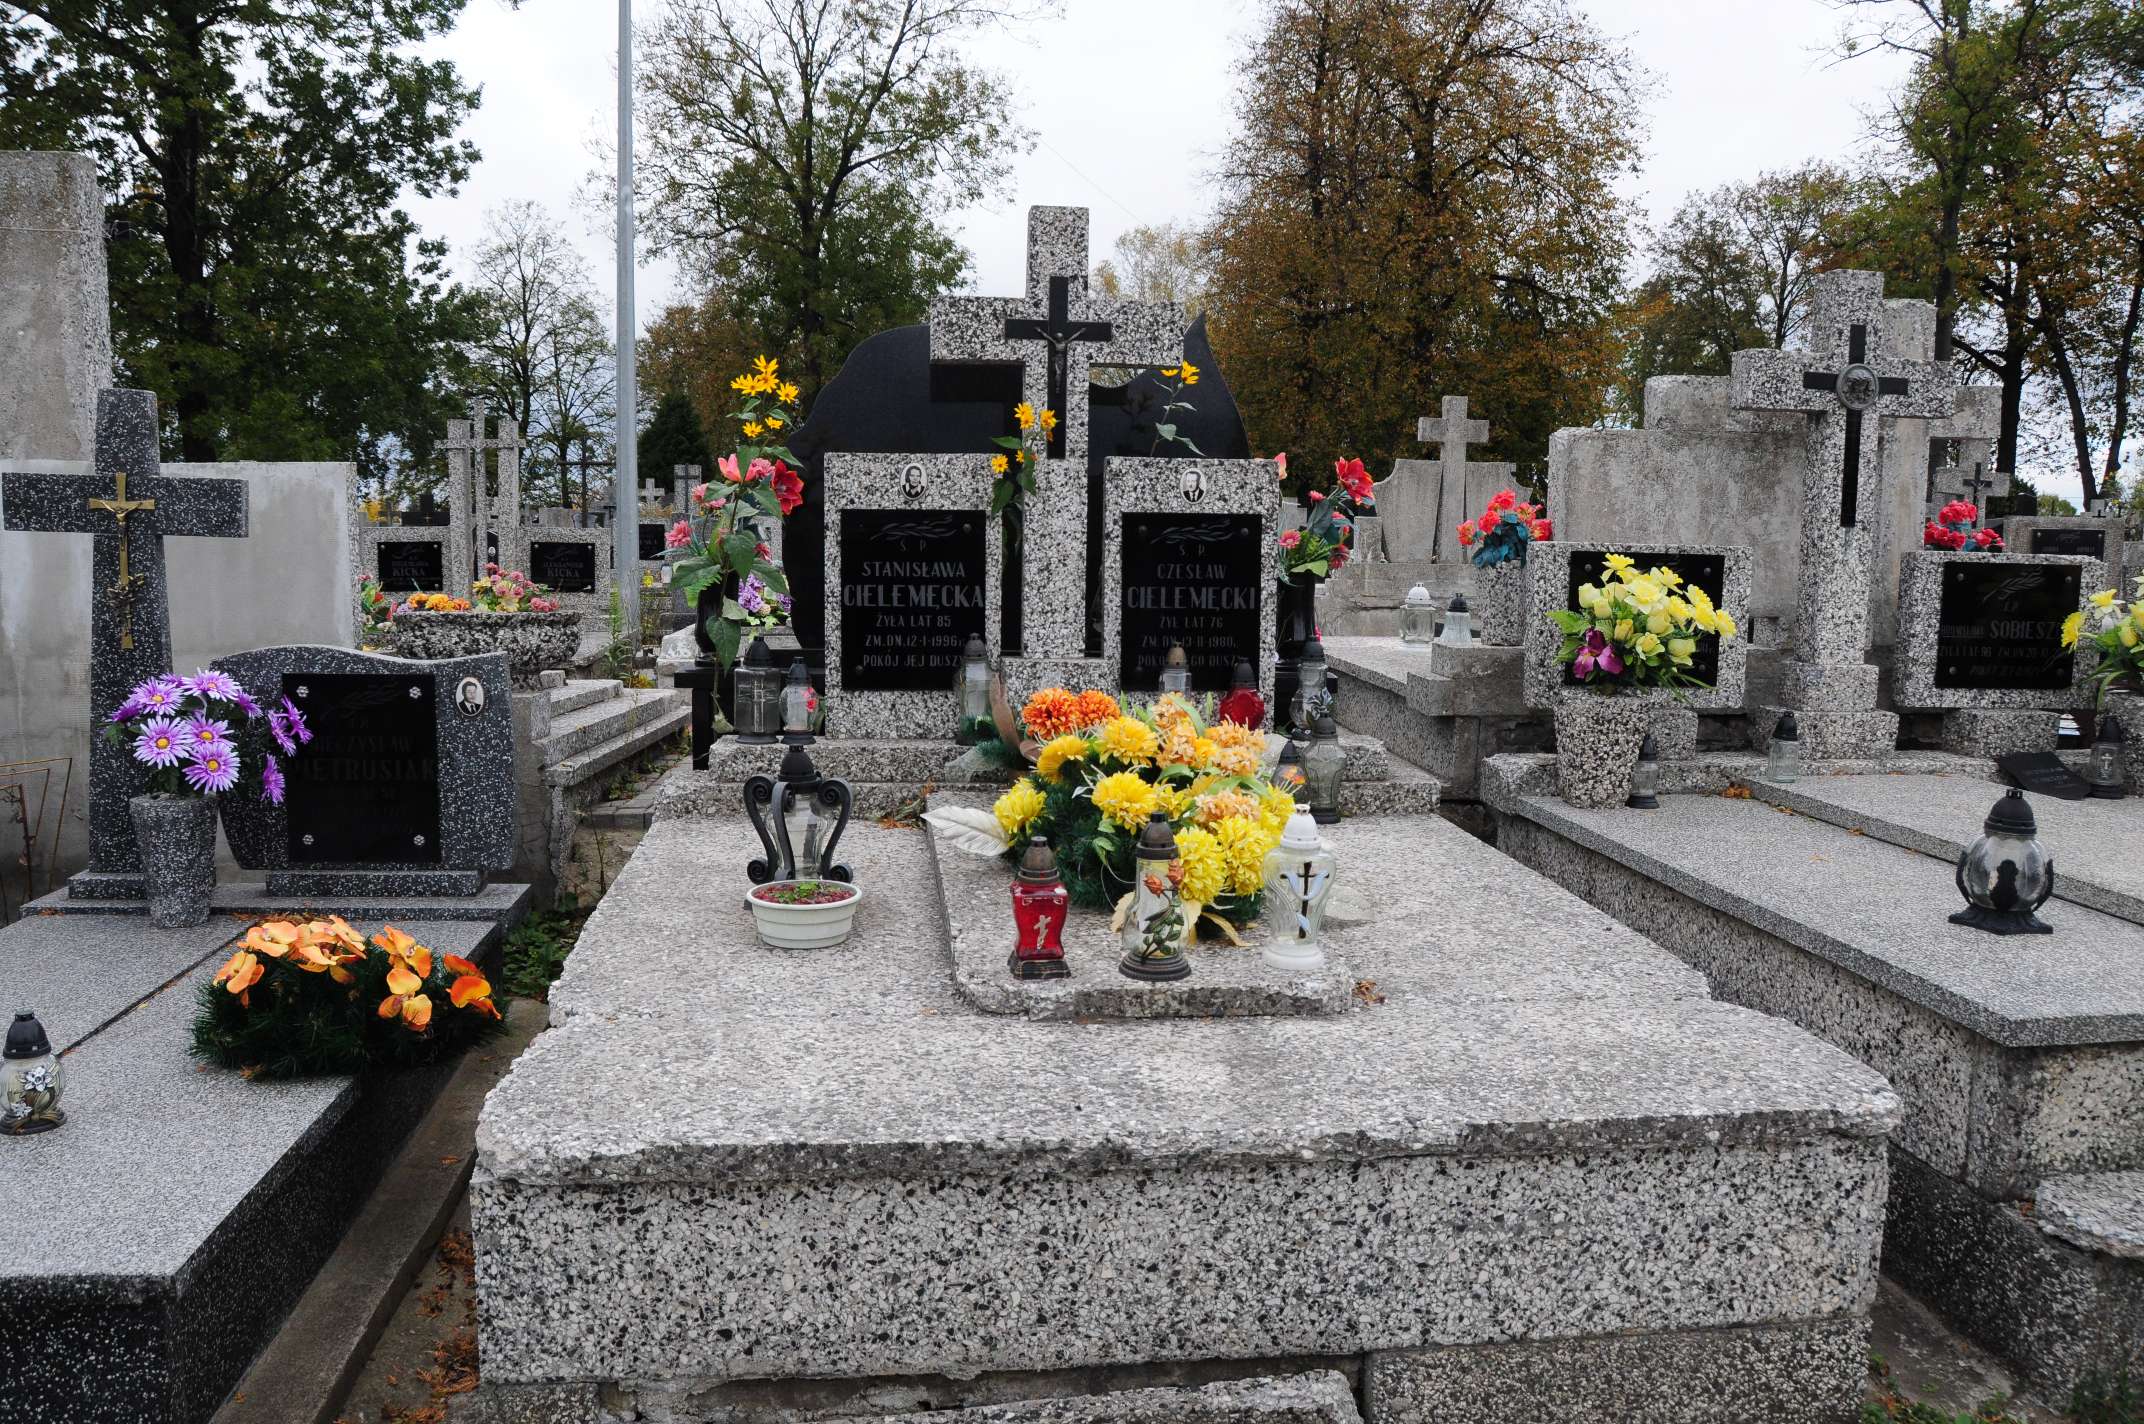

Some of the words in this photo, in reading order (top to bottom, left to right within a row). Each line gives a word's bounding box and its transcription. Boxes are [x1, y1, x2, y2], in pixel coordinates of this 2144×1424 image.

[862, 561, 966, 578] STANISŁAWA
[910, 615, 933, 628] LAT
[937, 615, 952, 628] 85
[1989, 620, 2056, 640] SOBIESZ
[904, 654, 926, 667] JEJ
